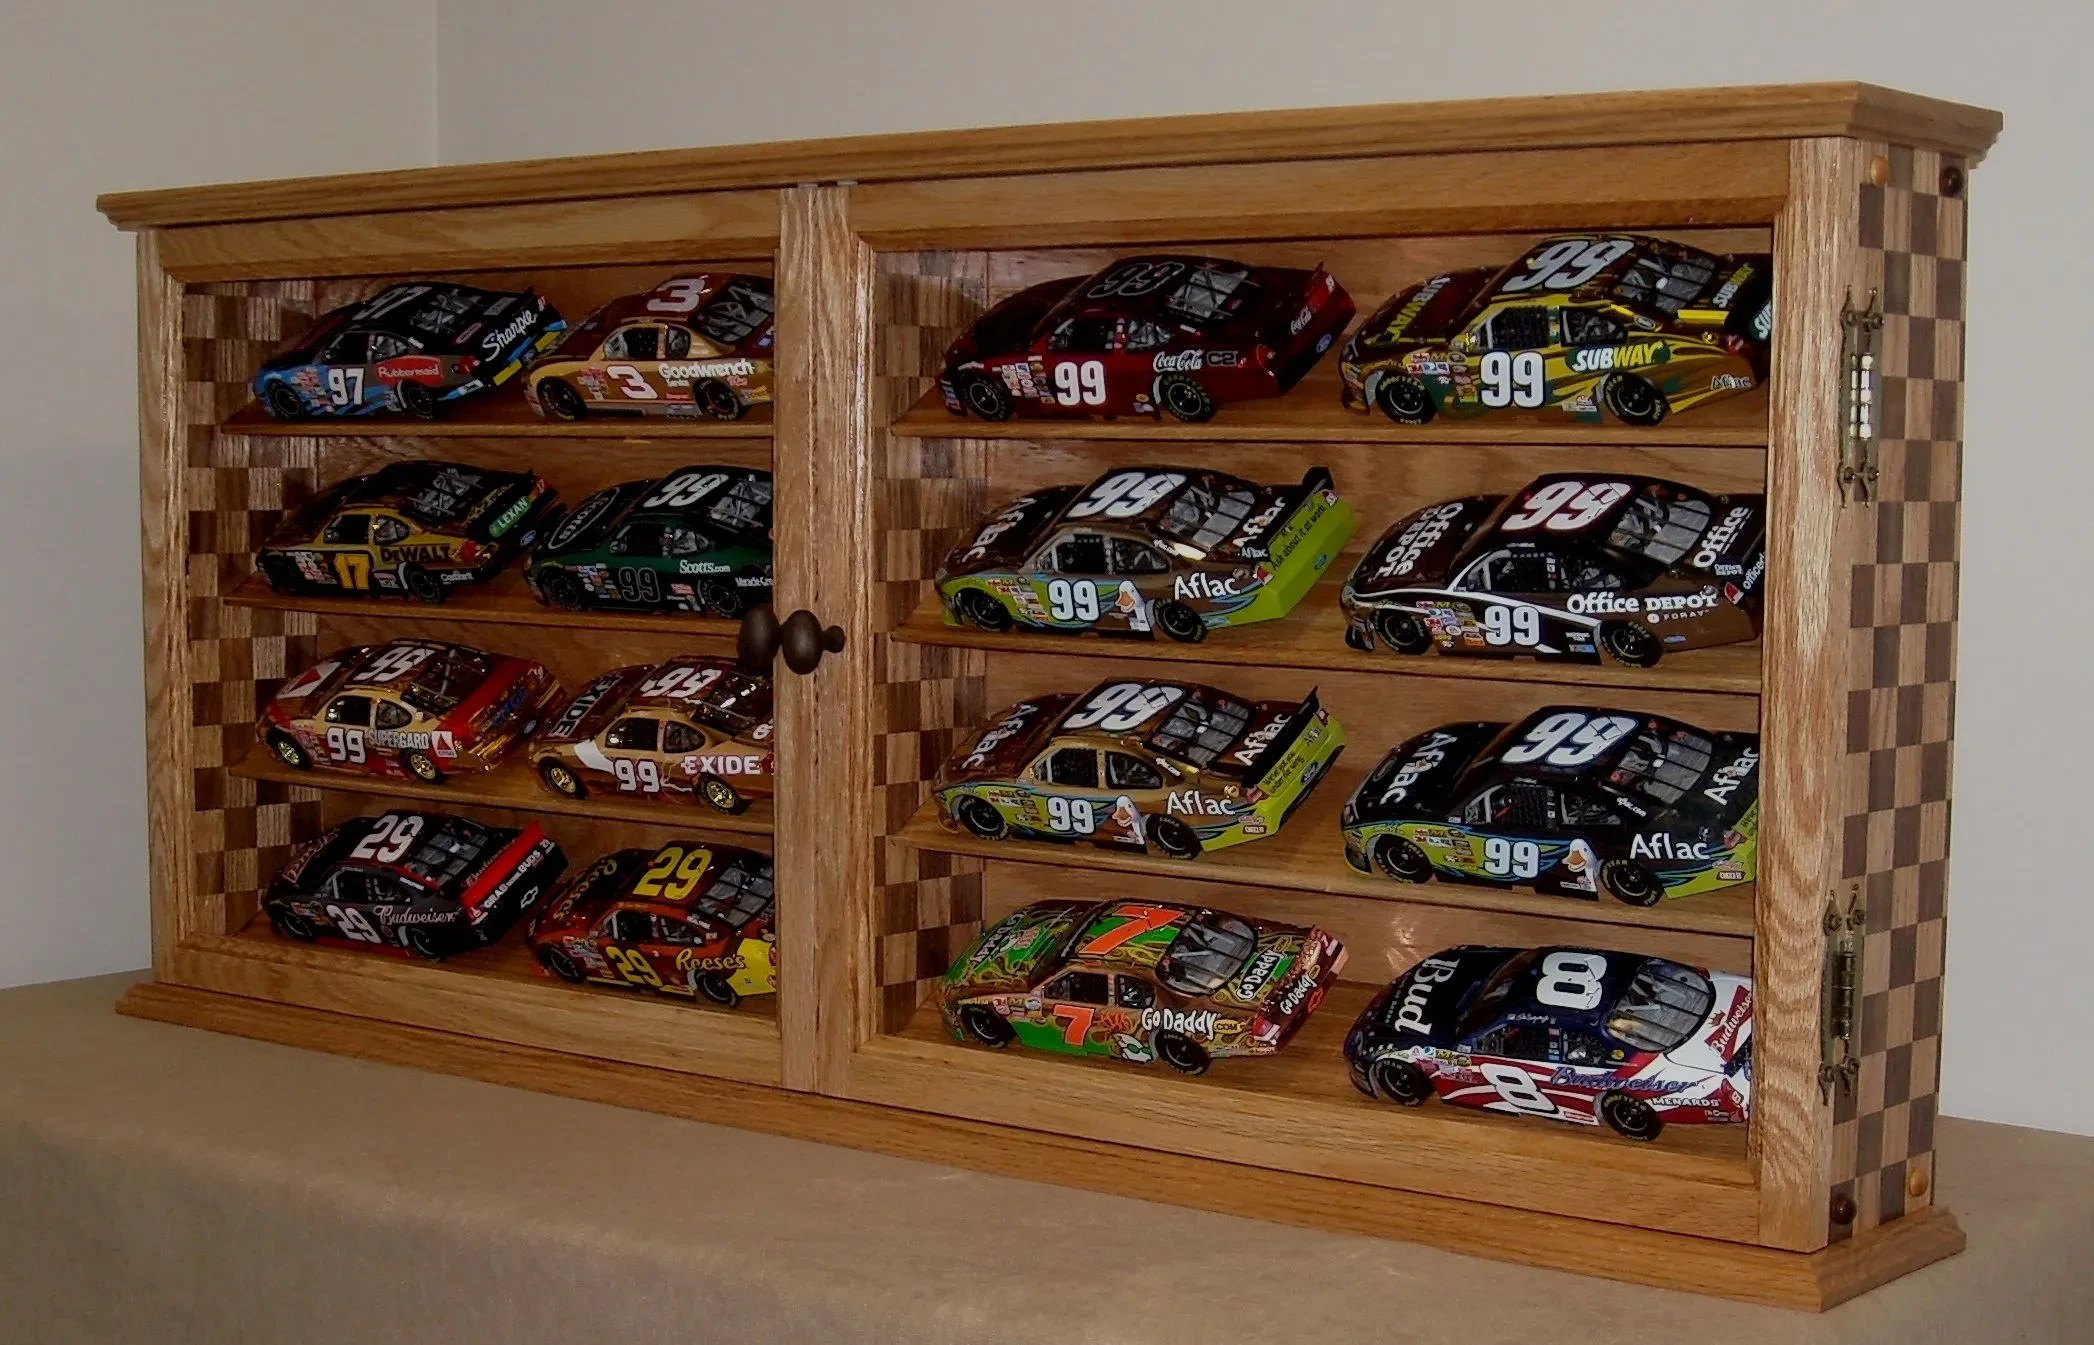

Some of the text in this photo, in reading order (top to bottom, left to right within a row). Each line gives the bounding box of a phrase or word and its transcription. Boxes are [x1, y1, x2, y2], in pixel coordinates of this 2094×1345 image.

[1502, 238, 1635, 291] 99
[647, 278, 706, 312] 3
[481, 310, 538, 362] Sharpie
[377, 363, 441, 379] Rubbermaid
[657, 357, 755, 380] Goodwrench
[1572, 340, 1665, 372] SUBWAY
[327, 367, 365, 405] 97
[606, 365, 658, 400] 3
[1054, 360, 1107, 406] 99
[1480, 350, 1545, 408] 99
[642, 473, 730, 507] 99
[1063, 471, 1188, 519] 99
[1500, 480, 1632, 531] 99
[496, 494, 530, 528] LEXAN
[1691, 505, 1750, 569] Office
[332, 552, 370, 590] 17
[618, 566, 661, 602] 99
[1173, 572, 1241, 600] Aflac
[1048, 579, 1100, 622] 99
[1566, 590, 1719, 614] Office DEPOT
[1484, 605, 1540, 646] 99
[352, 647, 438, 682] 99
[638, 667, 723, 698] 99
[1062, 682, 1187, 732] 99
[326, 727, 367, 764] 99
[1499, 711, 1640, 765] 99
[614, 758, 662, 793] 99
[680, 755, 761, 775] EXIDE
[1046, 796, 1096, 834] 99
[1166, 789, 1236, 816] Aflac
[350, 814, 424, 863] 29
[1629, 831, 1712, 860] Aflac
[631, 846, 713, 901] 29
[1484, 837, 1540, 879] 99
[326, 904, 383, 944] 29
[372, 904, 459, 926] Budweiser
[1080, 903, 1188, 957] 7
[605, 946, 663, 988] 29
[675, 947, 747, 972] Reese's
[1394, 957, 1461, 1035] Bud
[1537, 951, 1608, 1011] 8
[1053, 1004, 1096, 1047] 7
[1479, 1062, 1557, 1112] 8
